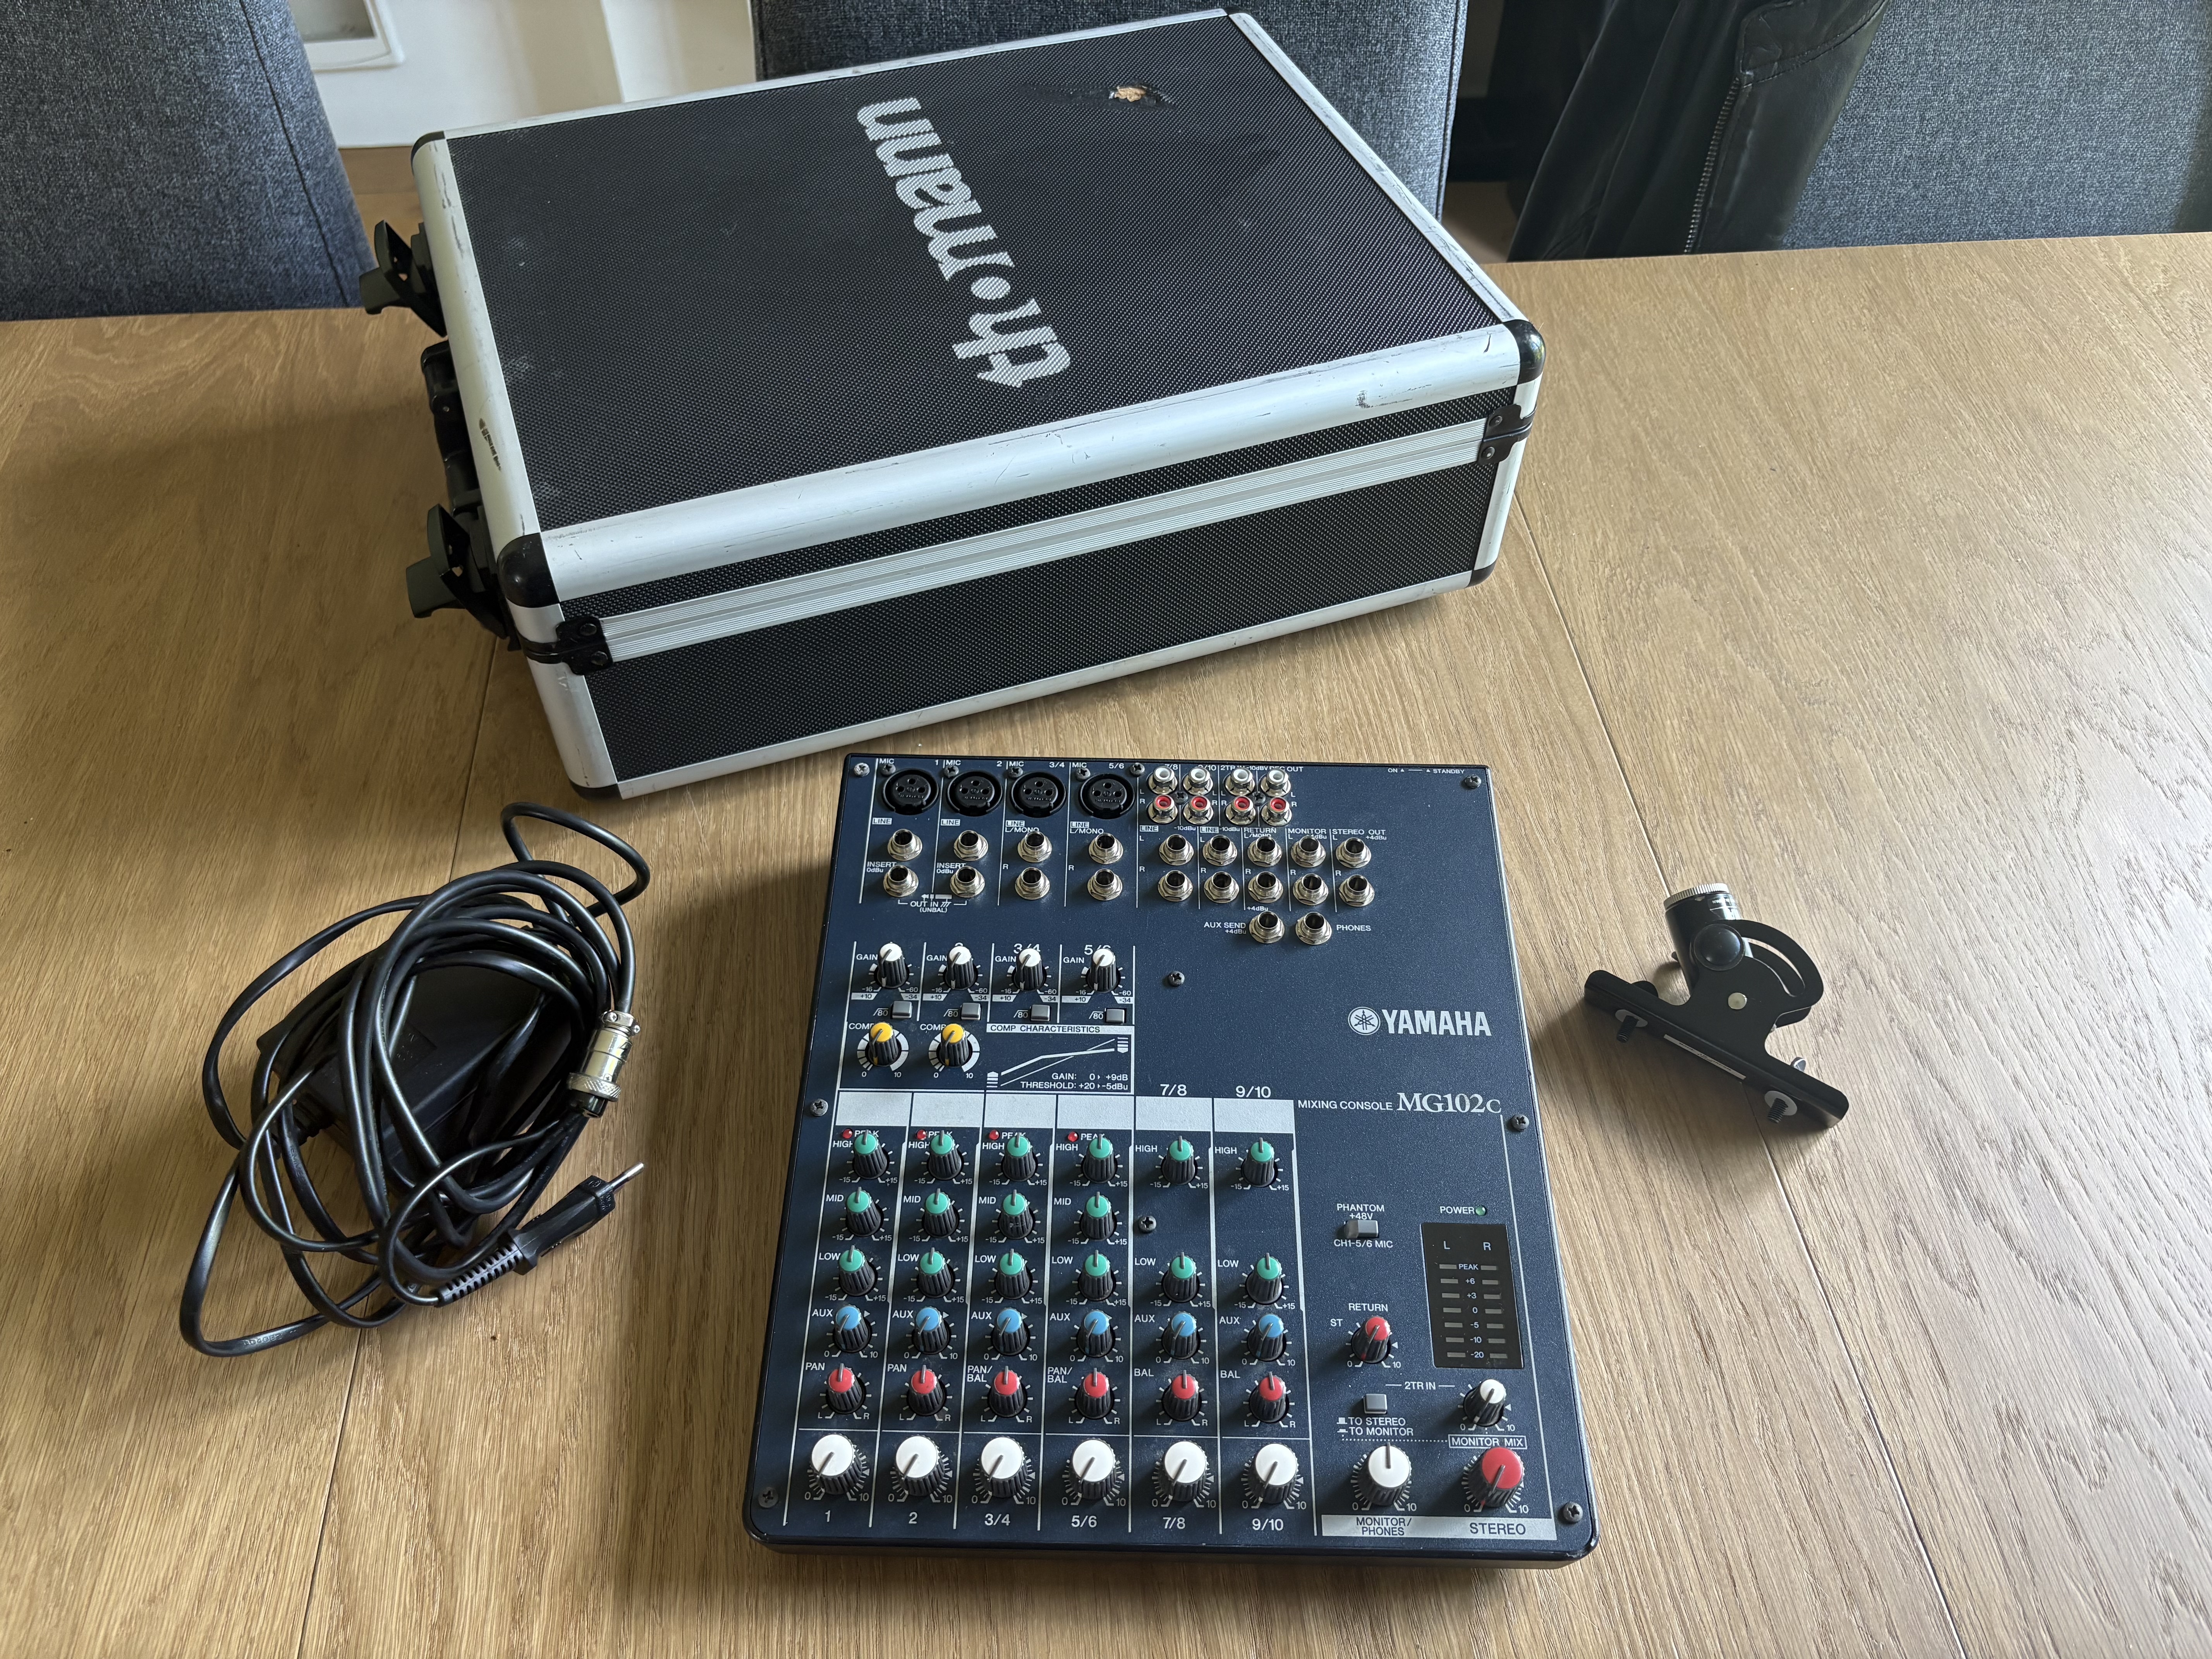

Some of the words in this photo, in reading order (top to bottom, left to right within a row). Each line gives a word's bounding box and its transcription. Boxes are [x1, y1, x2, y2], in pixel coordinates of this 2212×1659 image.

[1381, 1009, 1492, 1036] YAMAHA
[1160, 1084, 1187, 1096] 7/8
[1236, 1085, 1271, 1098] 9/10
[1298, 1100, 1337, 1109] MIXING
[1340, 1101, 1393, 1110] CONSOLE
[1337, 1204, 1384, 1212] PHANTOM
[1334, 1239, 1372, 1247] CH1-5/6
[1444, 1241, 1450, 1249] L
[1483, 1242, 1491, 1250] R
[1218, 1259, 1239, 1267] LOW
[1348, 1303, 1388, 1312] RETURN
[892, 1310, 913, 1318] AUX
[971, 1311, 992, 1319] AUX
[1049, 1313, 1070, 1321] AUX
[1135, 1314, 1155, 1322] AUX
[1219, 1316, 1240, 1324] AUX
[805, 1362, 825, 1370] PAN
[888, 1364, 907, 1372] PAN
[968, 1365, 993, 1374] PAN/
[967, 1374, 987, 1382] BAL
[1048, 1375, 1067, 1383] BAL
[1405, 1381, 1424, 1390] 2TR
[1426, 1382, 1436, 1390] IN
[1348, 1417, 1362, 1425] TO
[1366, 1417, 1405, 1426] STEREO
[1349, 1427, 1363, 1435] TO
[1366, 1427, 1413, 1436] MONITOR
[1452, 1437, 1500, 1446] MONITOR
[1504, 1438, 1523, 1446] MIX
[805, 1492, 811, 1500] 0
[859, 1493, 869, 1501] 10
[825, 1510, 830, 1522] 1
[908, 1512, 917, 1524] 2
[985, 1513, 1010, 1525] 3/4
[1072, 1515, 1097, 1527] 5/6
[1163, 1517, 1185, 1529] 7/8
[1252, 1518, 1283, 1531] 9/10
[1356, 1517, 1412, 1527] MONITOR/
[1362, 1527, 1404, 1536] PHONES
[1470, 1522, 1526, 1535] STEREO
